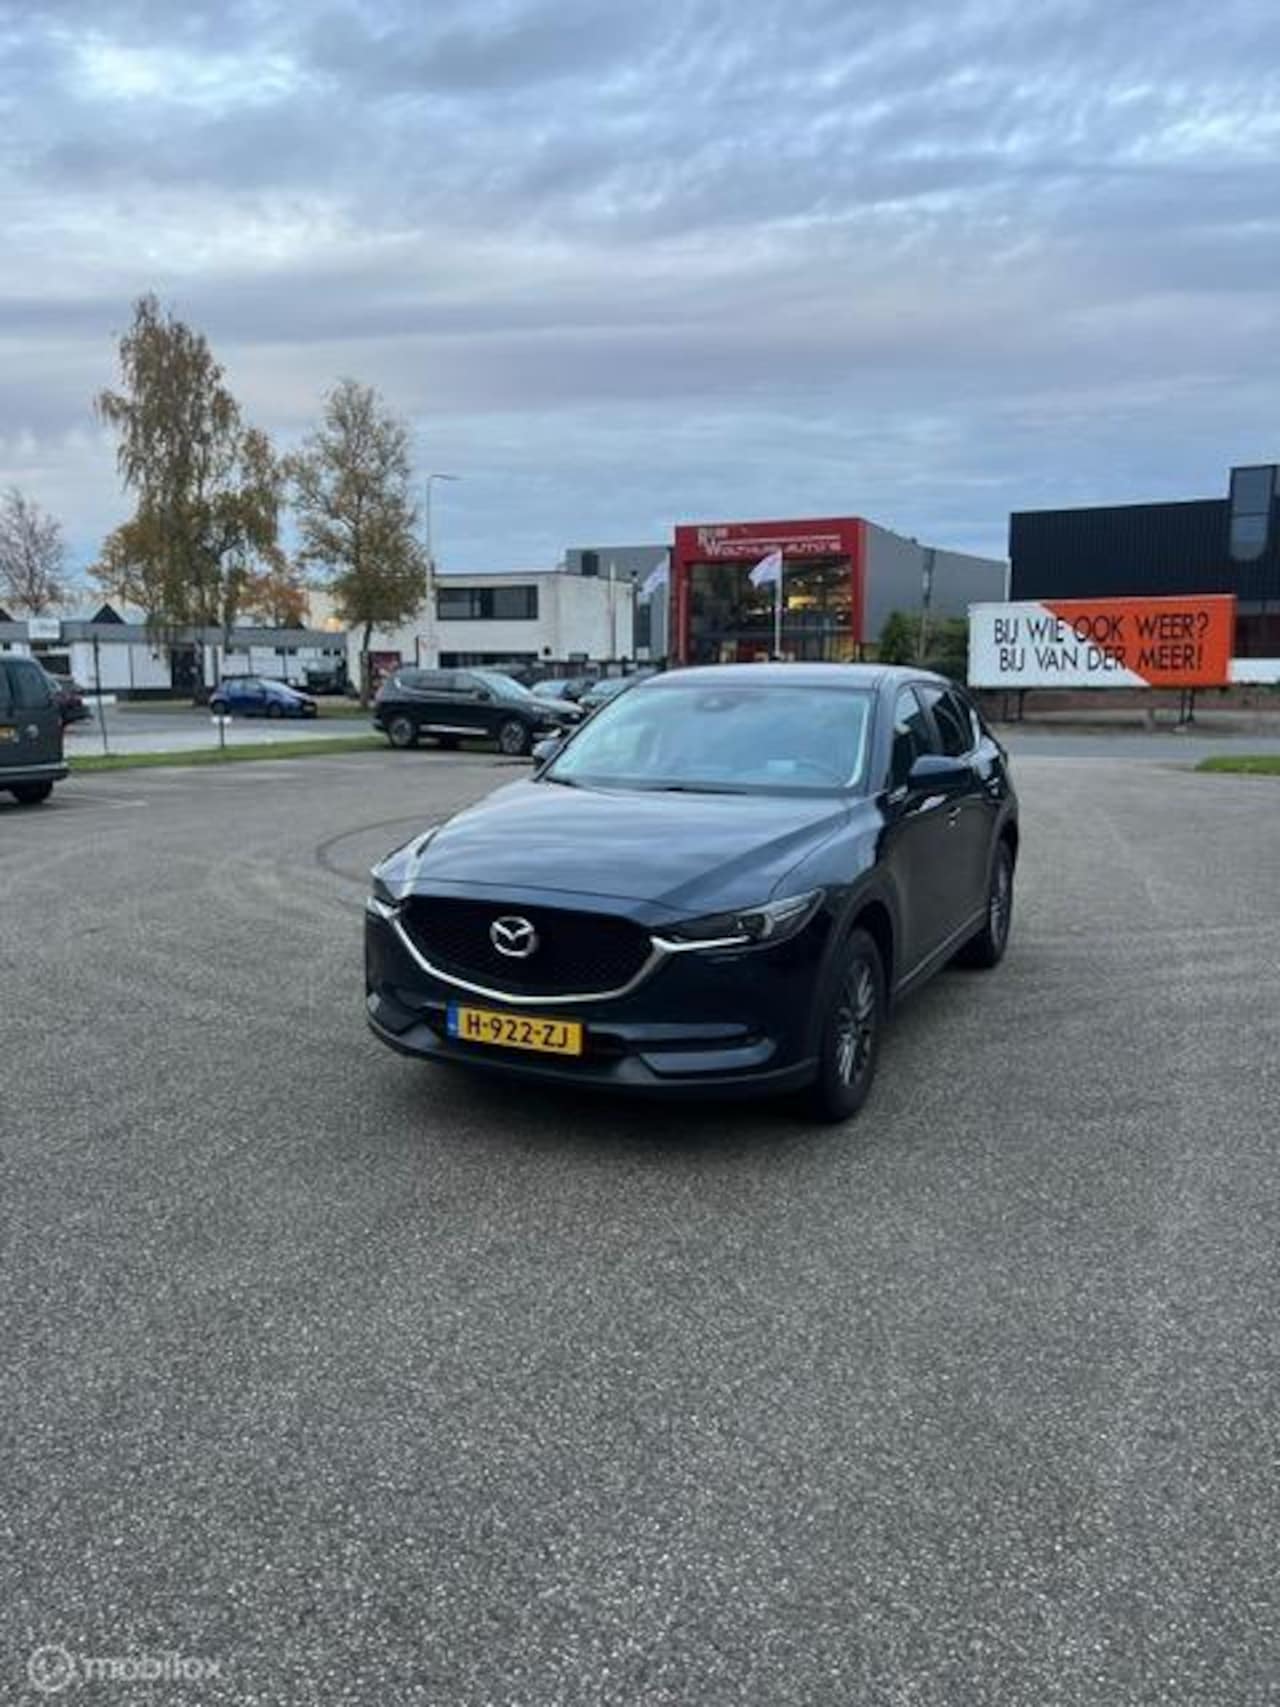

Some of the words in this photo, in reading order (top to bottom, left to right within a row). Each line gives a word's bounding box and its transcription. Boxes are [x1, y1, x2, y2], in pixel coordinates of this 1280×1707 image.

[995, 618, 1019, 644] BIJ
[1028, 618, 1064, 643] WIE
[1073, 615, 1124, 643] OOK
[1137, 612, 1209, 639] WEER?
[1001, 648, 1025, 671] BIJ
[1034, 649, 1078, 670] VAN
[1087, 647, 1126, 670] DER
[1138, 644, 1204, 669] MEER!
[466, 1013, 569, 1048] H-922-ZJ
